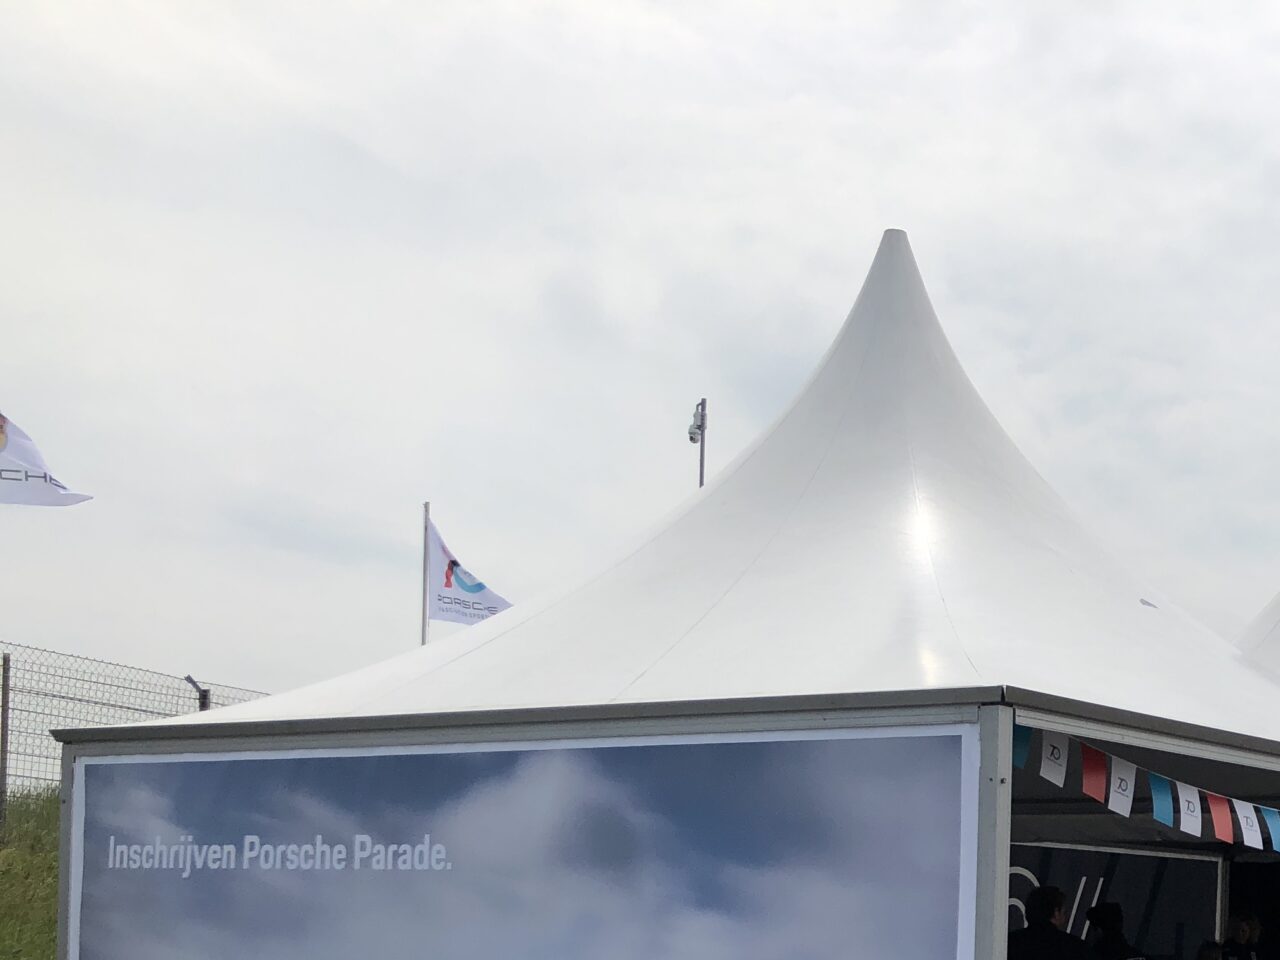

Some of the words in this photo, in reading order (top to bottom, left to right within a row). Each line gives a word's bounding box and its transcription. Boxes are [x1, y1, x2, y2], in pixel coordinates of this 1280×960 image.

[108, 835, 236, 878] Inschrijven
[243, 834, 346, 870] Porsche
[354, 834, 452, 870] Parade.
